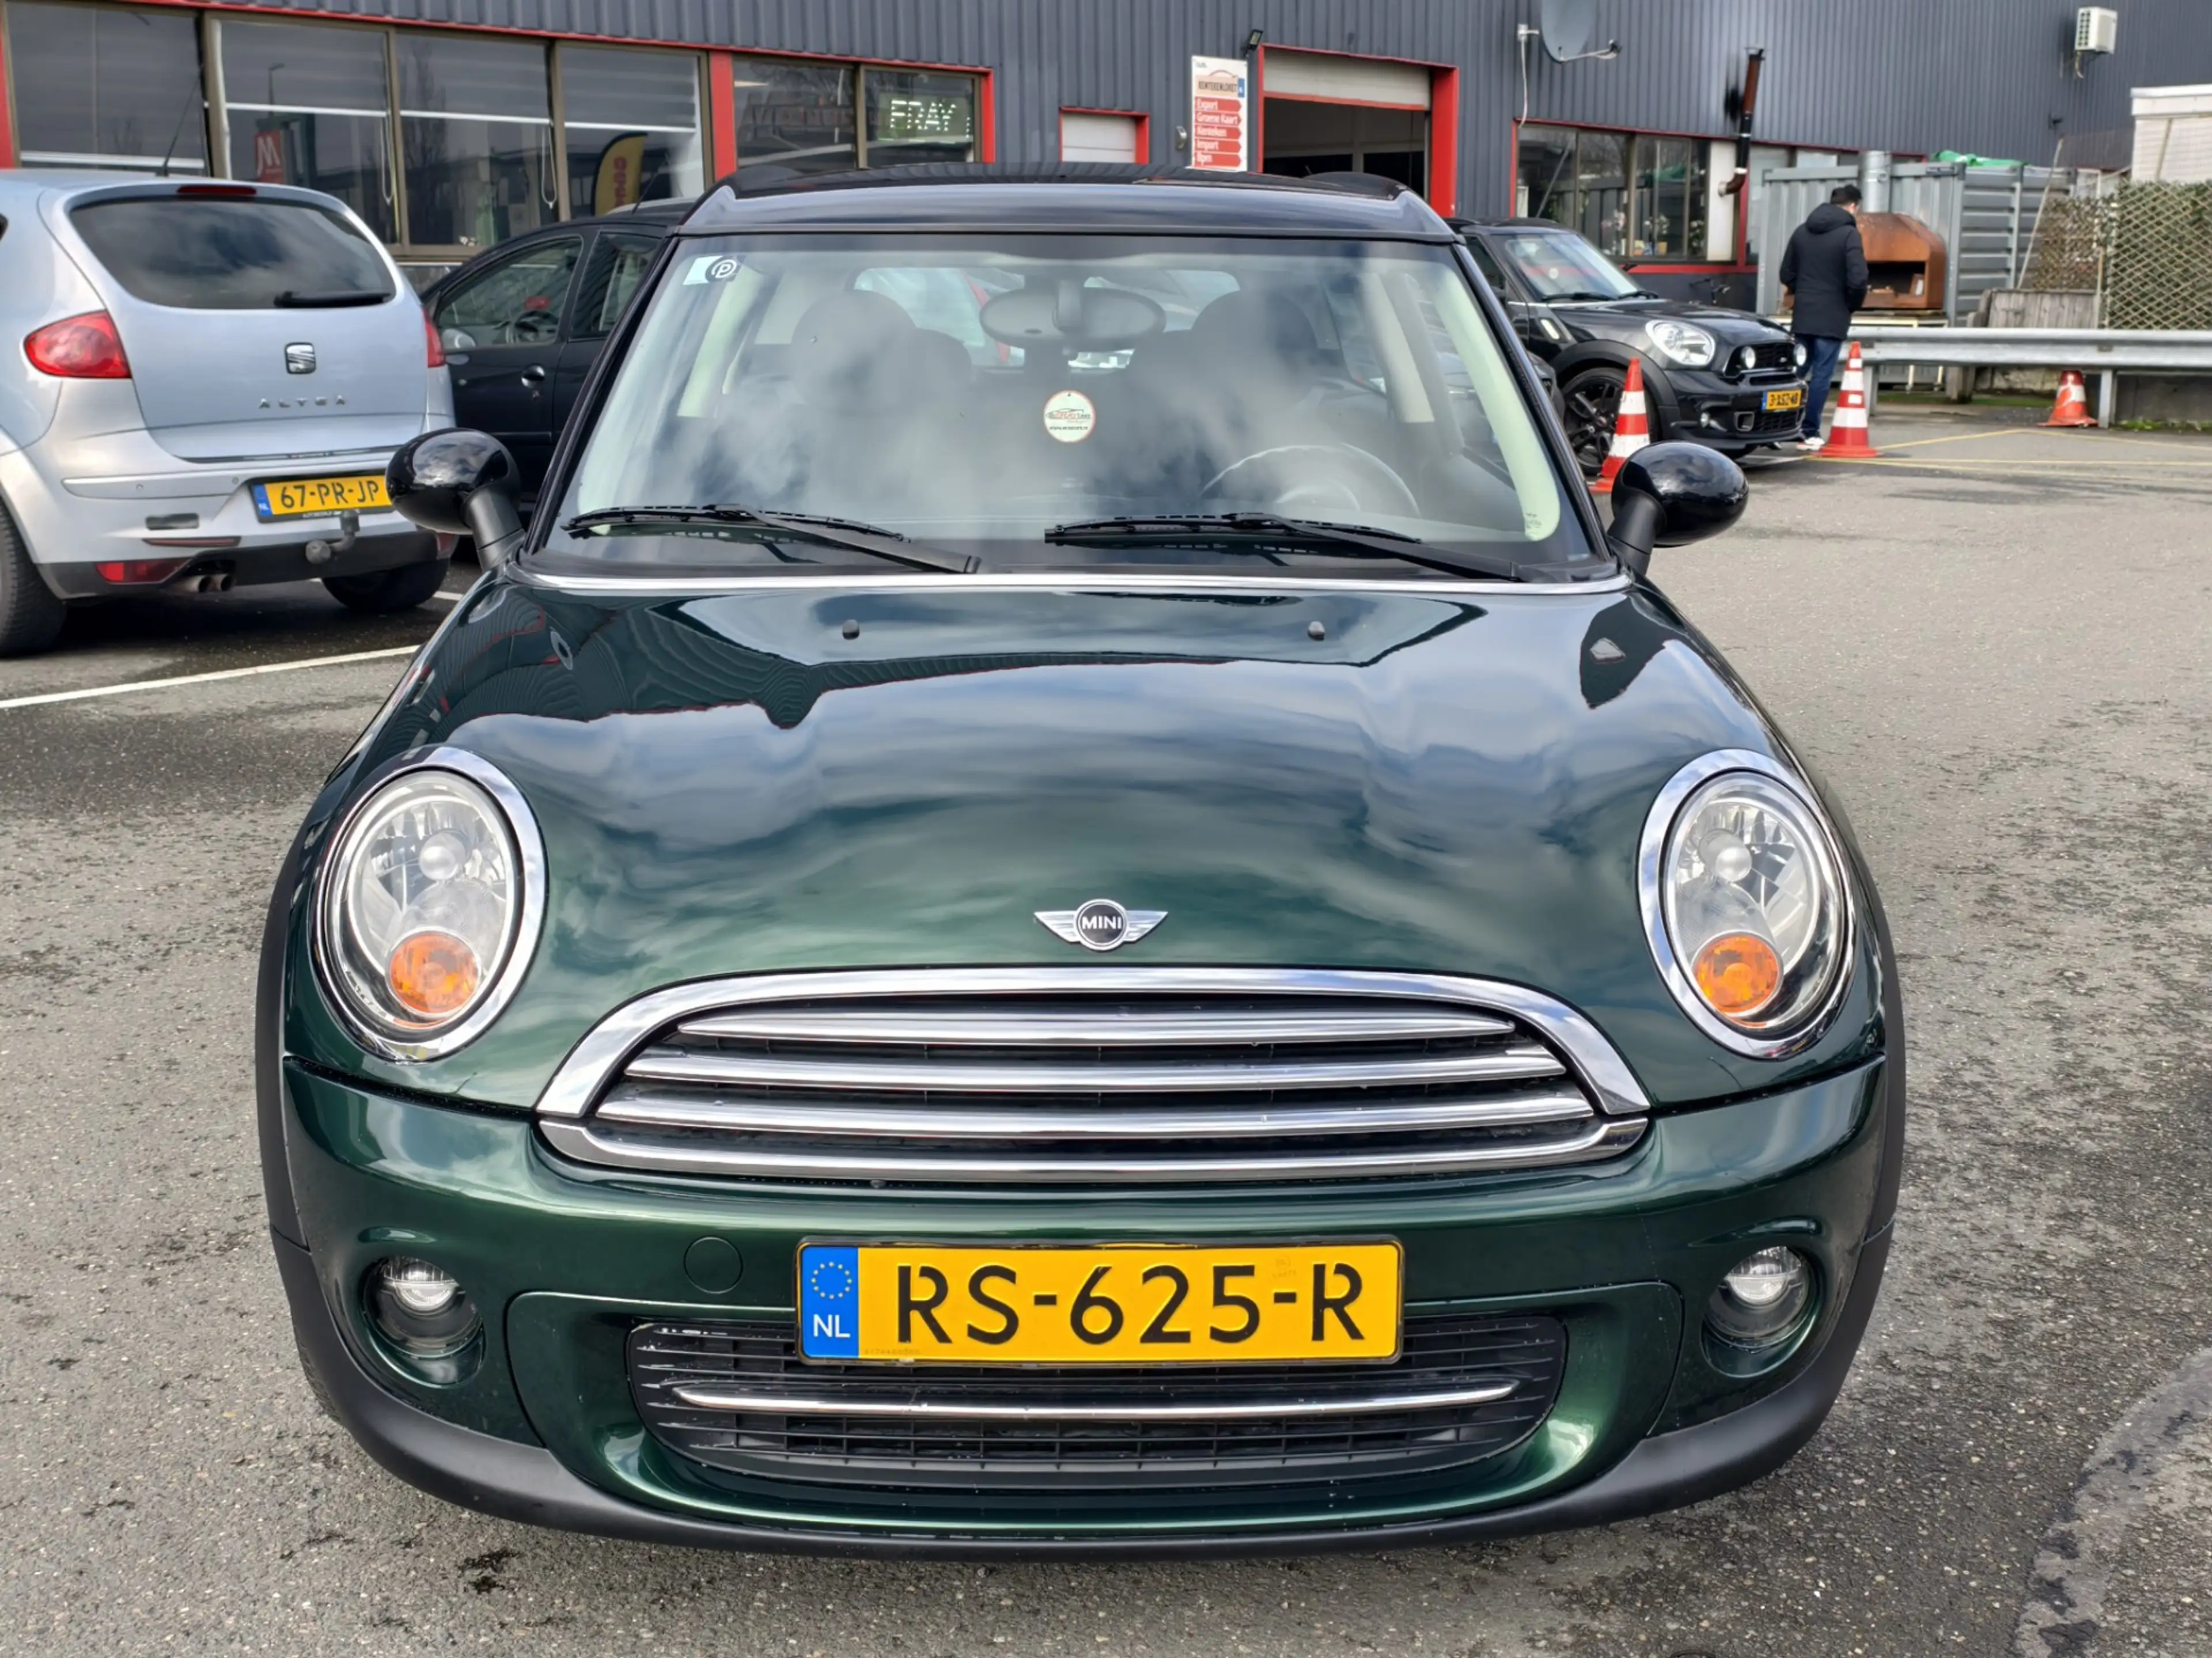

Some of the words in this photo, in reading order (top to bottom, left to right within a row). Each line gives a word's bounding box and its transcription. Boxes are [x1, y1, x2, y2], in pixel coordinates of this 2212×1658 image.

[1197, 98, 1218, 111] Export
[1196, 112, 1220, 123] Groene
[1221, 114, 1238, 124] Kaart
[1197, 139, 1219, 151] Import
[259, 394, 346, 409] ALTEA
[280, 480, 380, 509] 67-PR-JP
[1082, 916, 1122, 929] MINI
[895, 1262, 1366, 1345] RS-625-R
[813, 1313, 851, 1338] NL
